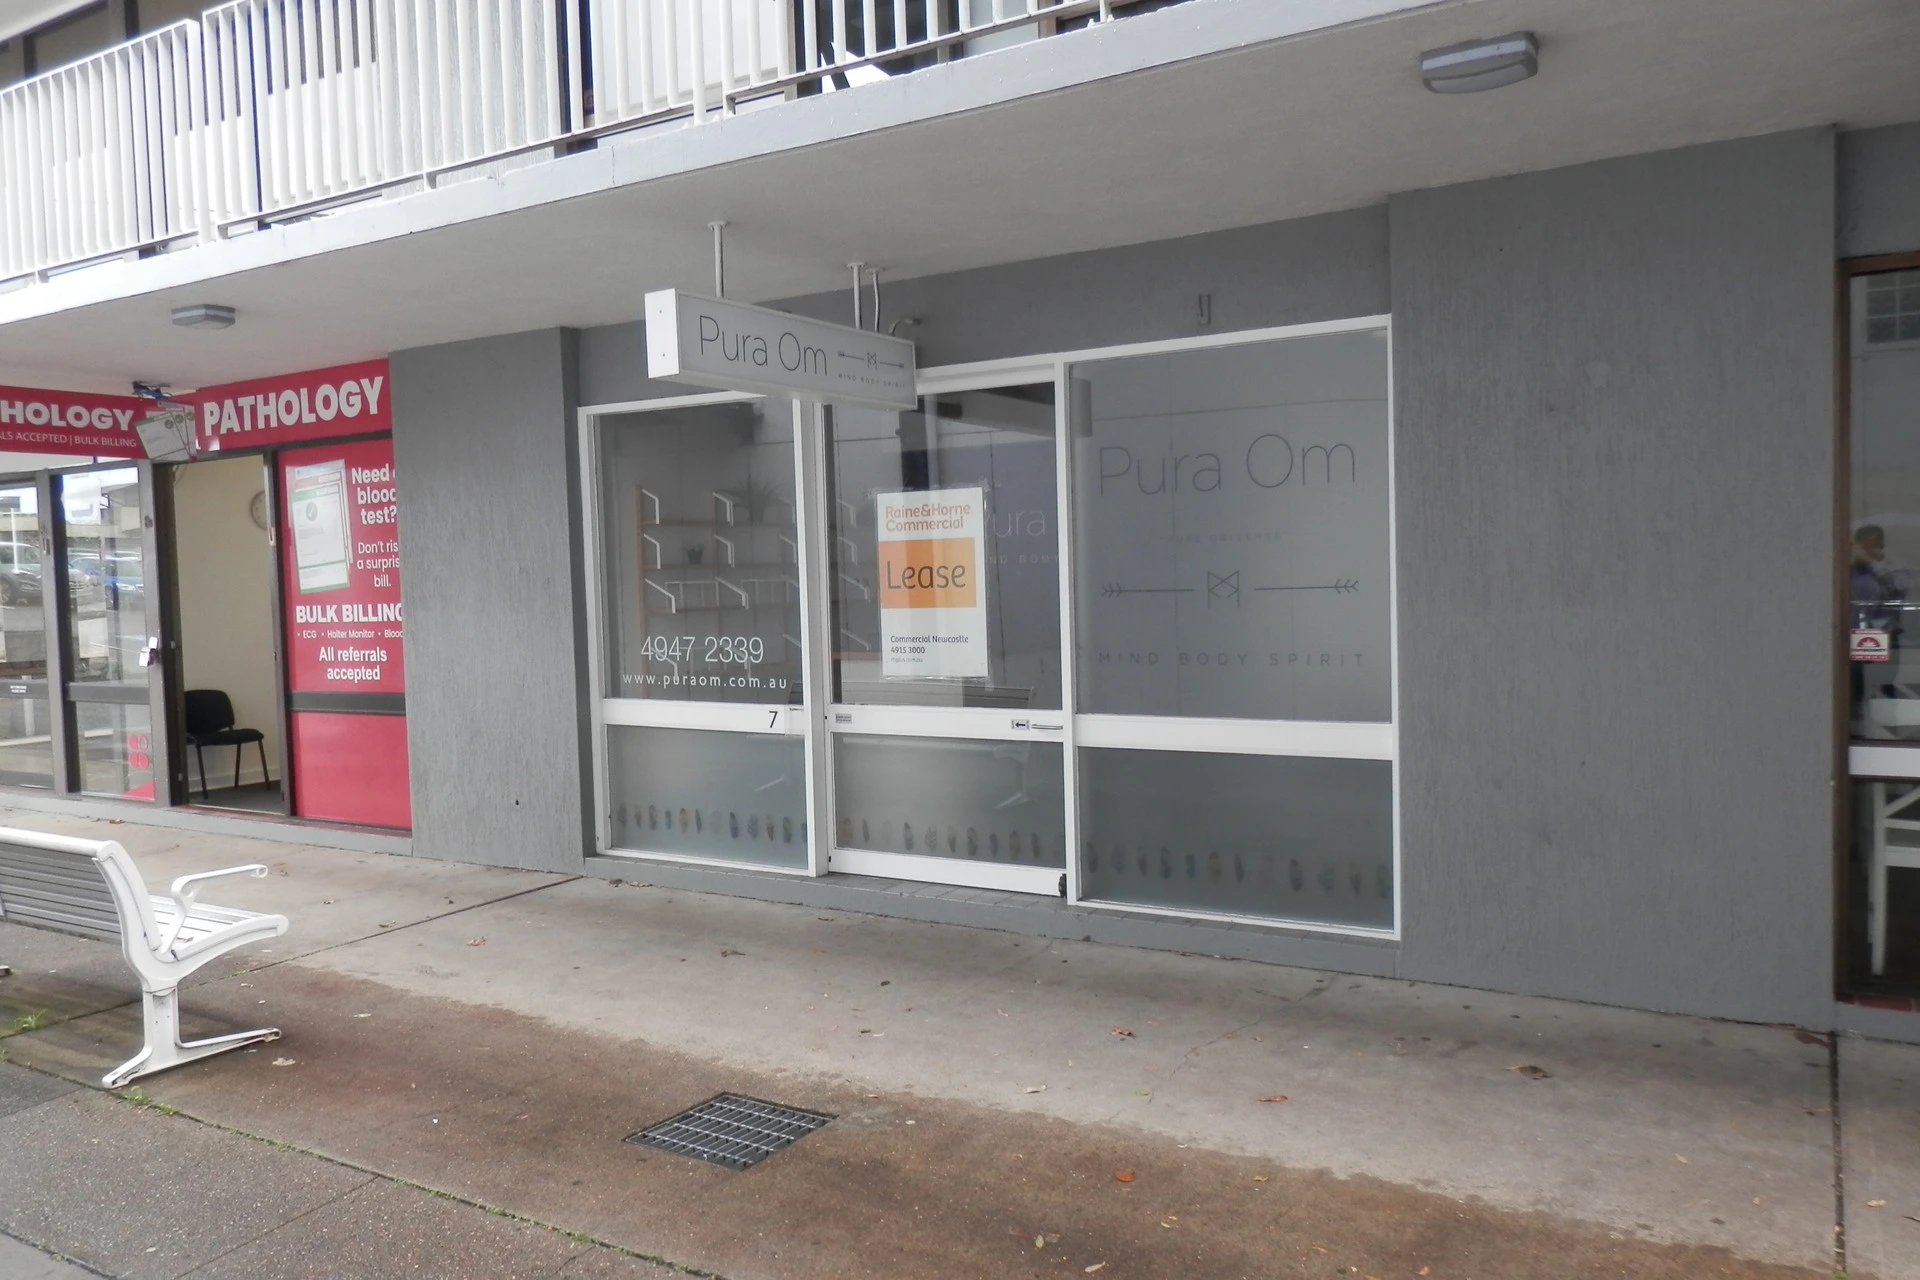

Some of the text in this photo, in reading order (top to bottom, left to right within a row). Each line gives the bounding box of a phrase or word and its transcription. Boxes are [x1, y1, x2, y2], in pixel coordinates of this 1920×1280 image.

[700, 315, 828, 377] Pura Om
[203, 376, 384, 436] PATHOLOGY
[0, 431, 137, 448] LS ACCEPTED BULK BILLING
[351, 463, 390, 484] Need
[1099, 434, 1355, 496] Pura Om
[361, 505, 397, 525] test?
[885, 515, 964, 532] Commercial
[358, 541, 385, 554] Don't
[356, 559, 364, 570] a
[373, 574, 392, 587] bill.
[887, 560, 966, 590] Lease
[296, 604, 338, 623] BULK
[303, 630, 317, 639] ECG
[327, 630, 347, 639] Holter
[348, 629, 375, 639] Monitor
[890, 634, 969, 644] Commercial Newcastle
[319, 646, 388, 662] All referrals
[640, 635, 764, 664] 4947 2339
[890, 646, 926, 654] 4915 3000
[1098, 653, 1364, 666] MIND BODY SPIRIT
[327, 665, 381, 683] accepted
[622, 673, 788, 689] www.puraom.com.au
[768, 711, 778, 728] 7
